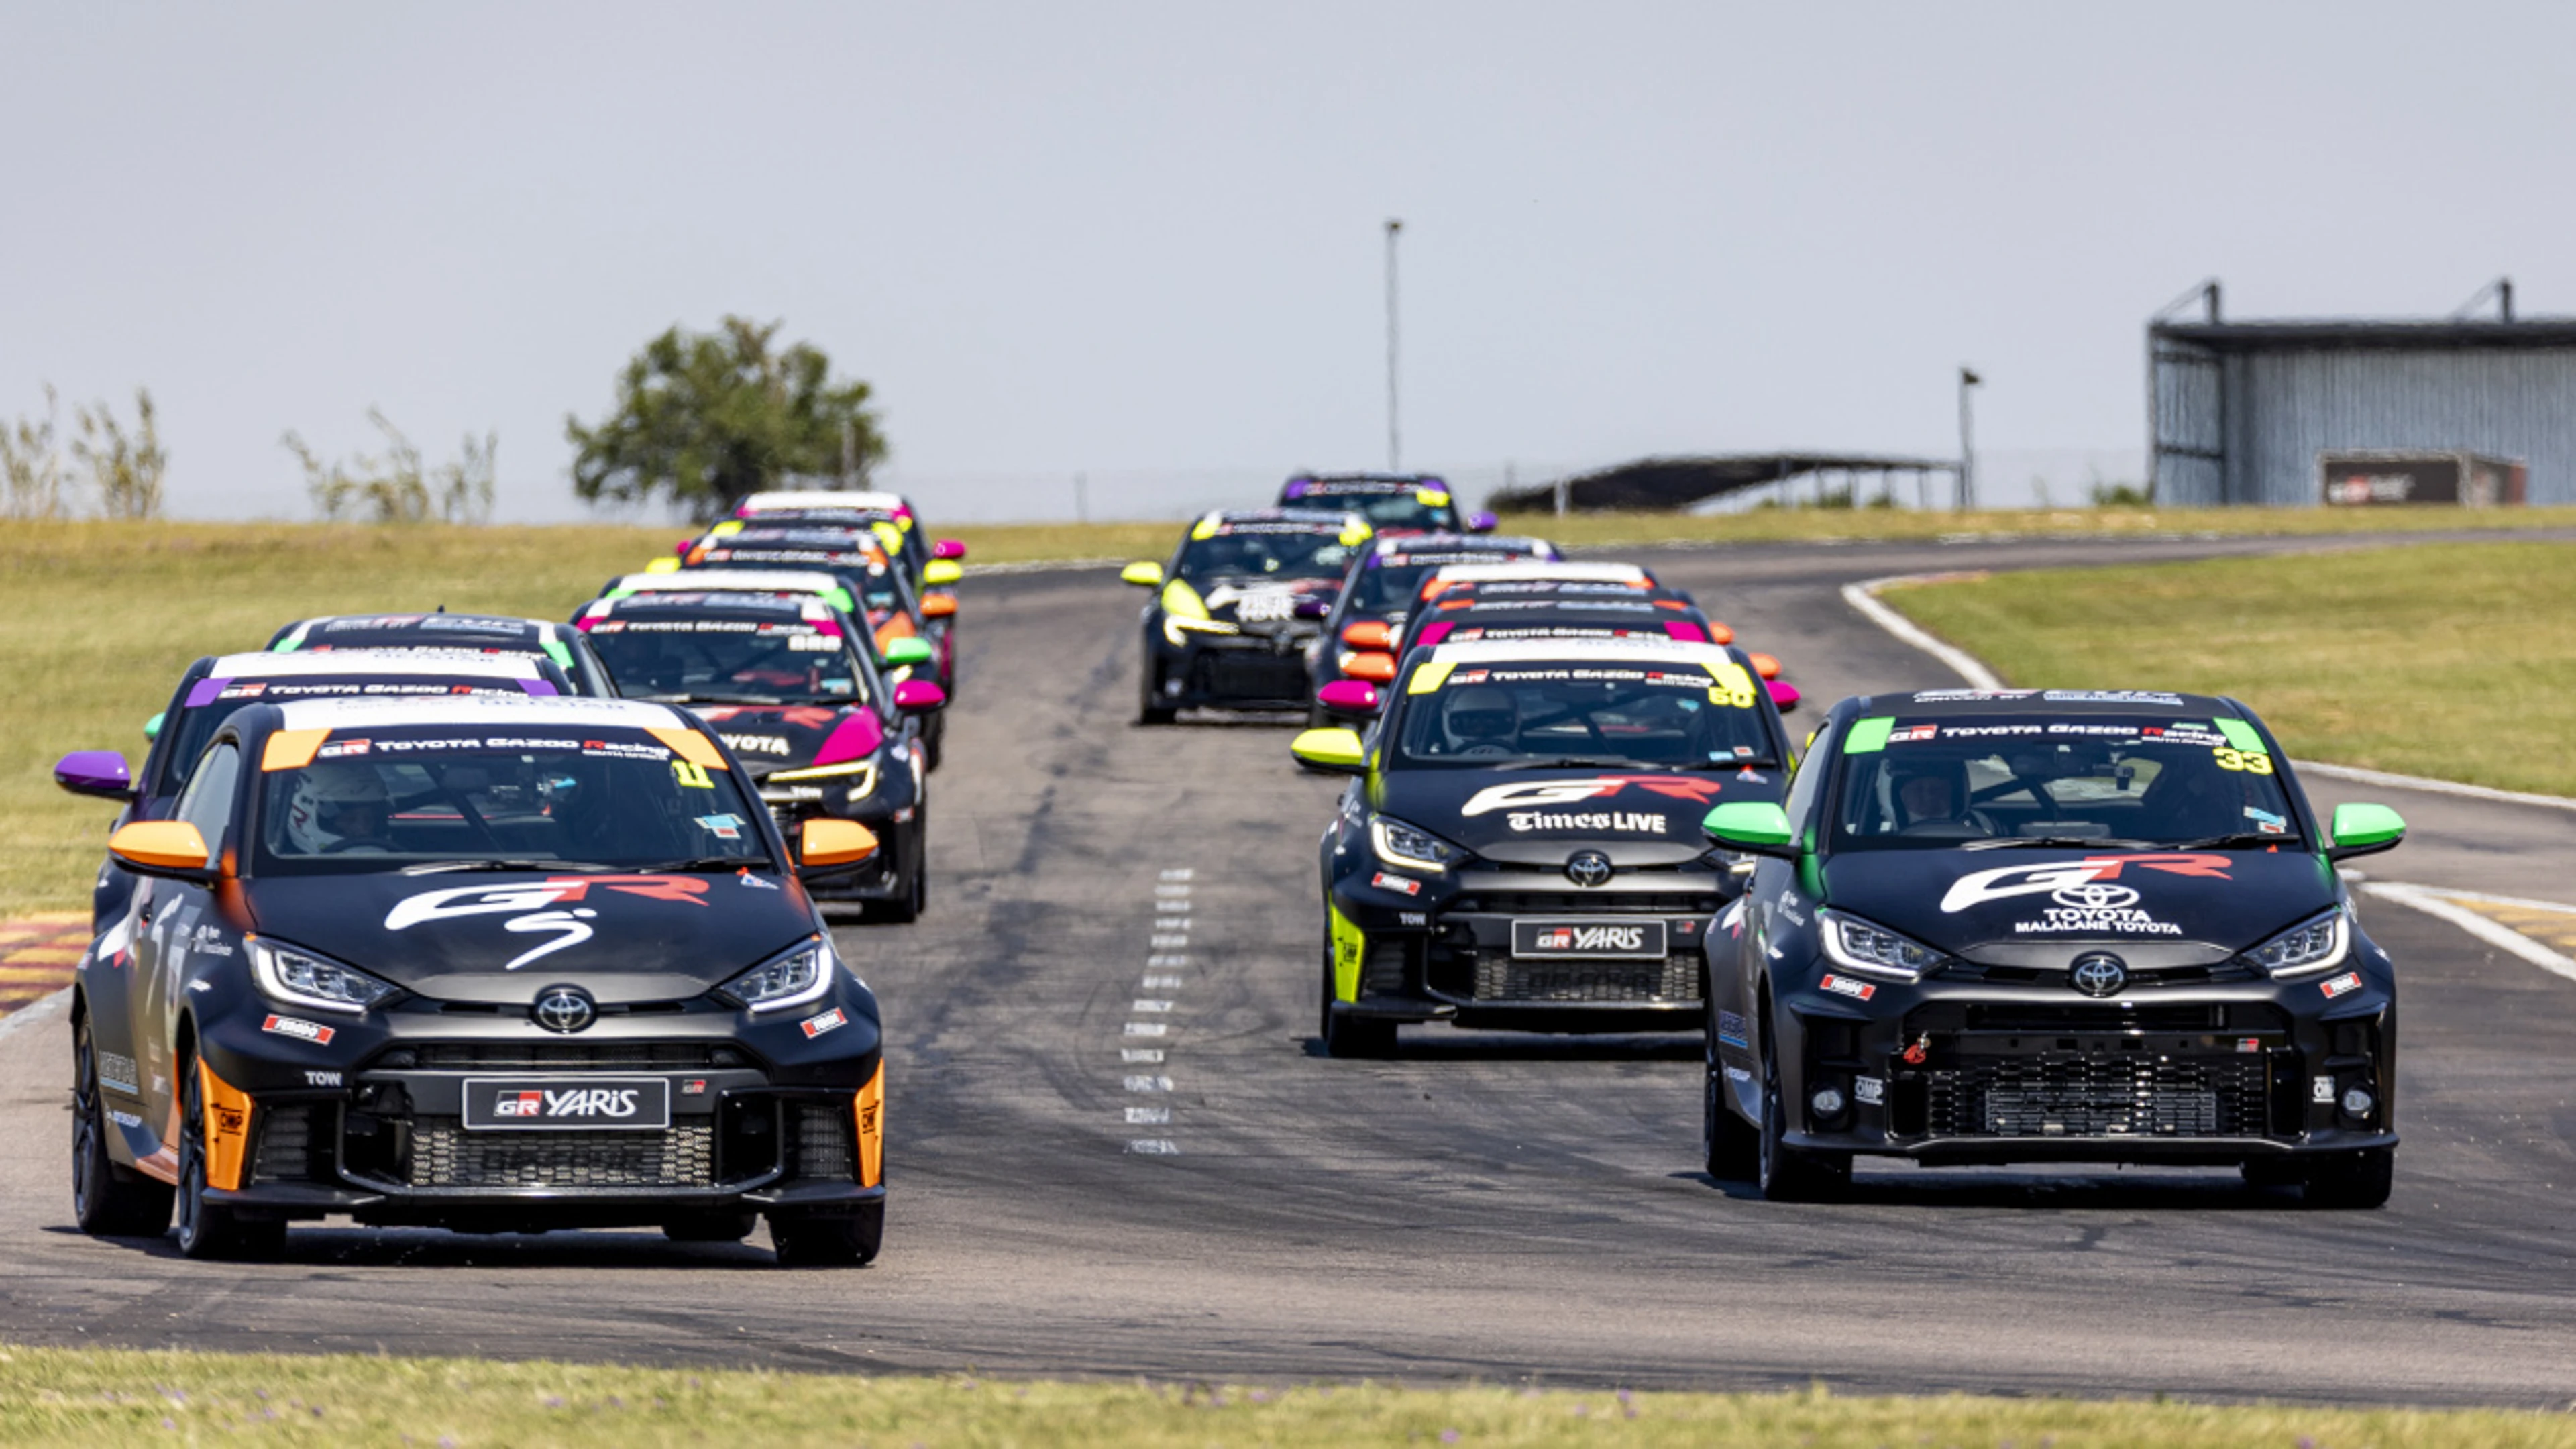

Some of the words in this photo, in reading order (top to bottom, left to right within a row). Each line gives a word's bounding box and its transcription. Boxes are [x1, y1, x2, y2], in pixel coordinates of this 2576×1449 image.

[1491, 670, 1570, 682] TOYOTA
[270, 684, 360, 694] TOYOTA
[364, 684, 448, 694] GAZOO
[719, 733, 791, 757] YOTA
[1943, 724, 2043, 737] TOYOTA
[2048, 723, 2139, 735] GAZOO
[2142, 727, 2227, 745] Racing
[374, 739, 482, 751] TOYOTA
[486, 738, 580, 749] GAZOO
[583, 740, 671, 757] Racing
[2213, 747, 2273, 775] 33
[672, 759, 716, 789] 11
[1461, 775, 1721, 817] GR
[1940, 853, 2233, 913] GR
[384, 875, 710, 930] GR
[2043, 908, 2151, 922] TOYOTA
[2015, 921, 2112, 933] MALALANE
[2113, 920, 2183, 935] TOYOTA
[304, 1071, 343, 1087] TOW
[1855, 1079, 1884, 1101] OMP
